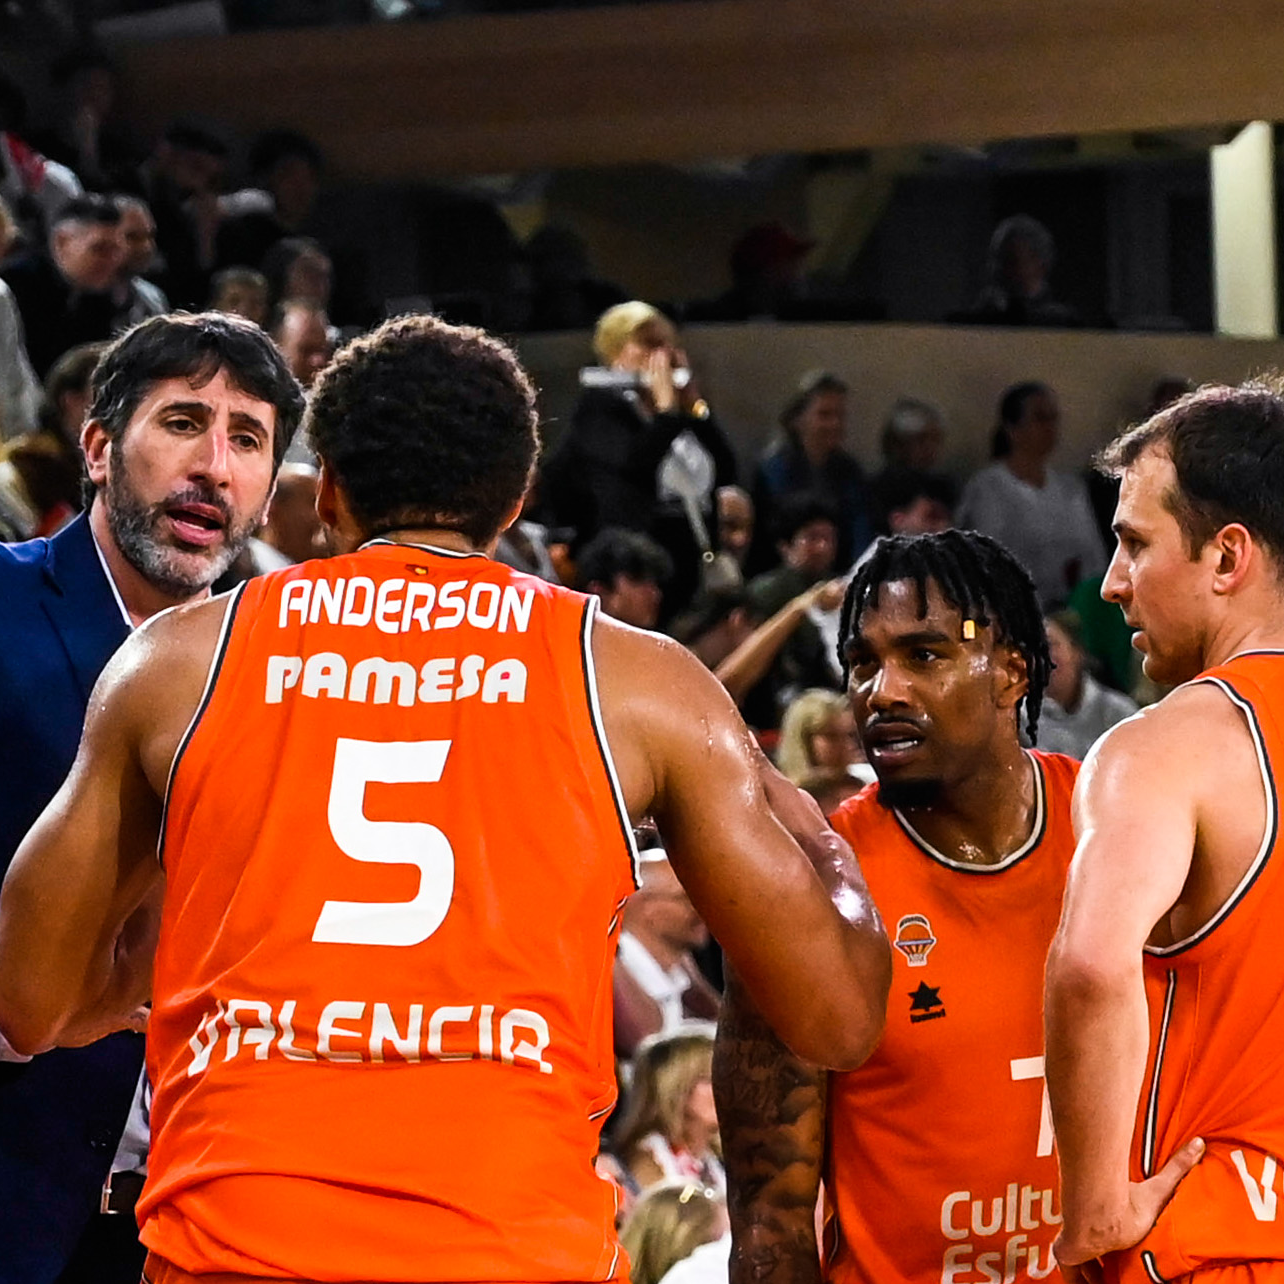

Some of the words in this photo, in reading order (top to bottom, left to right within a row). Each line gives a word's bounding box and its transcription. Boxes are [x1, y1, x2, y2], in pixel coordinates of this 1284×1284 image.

[279, 577, 535, 634] ANDERSON
[264, 652, 528, 706] PAMESA
[312, 738, 455, 947] 5
[187, 1000, 553, 1078] VALENCIA
